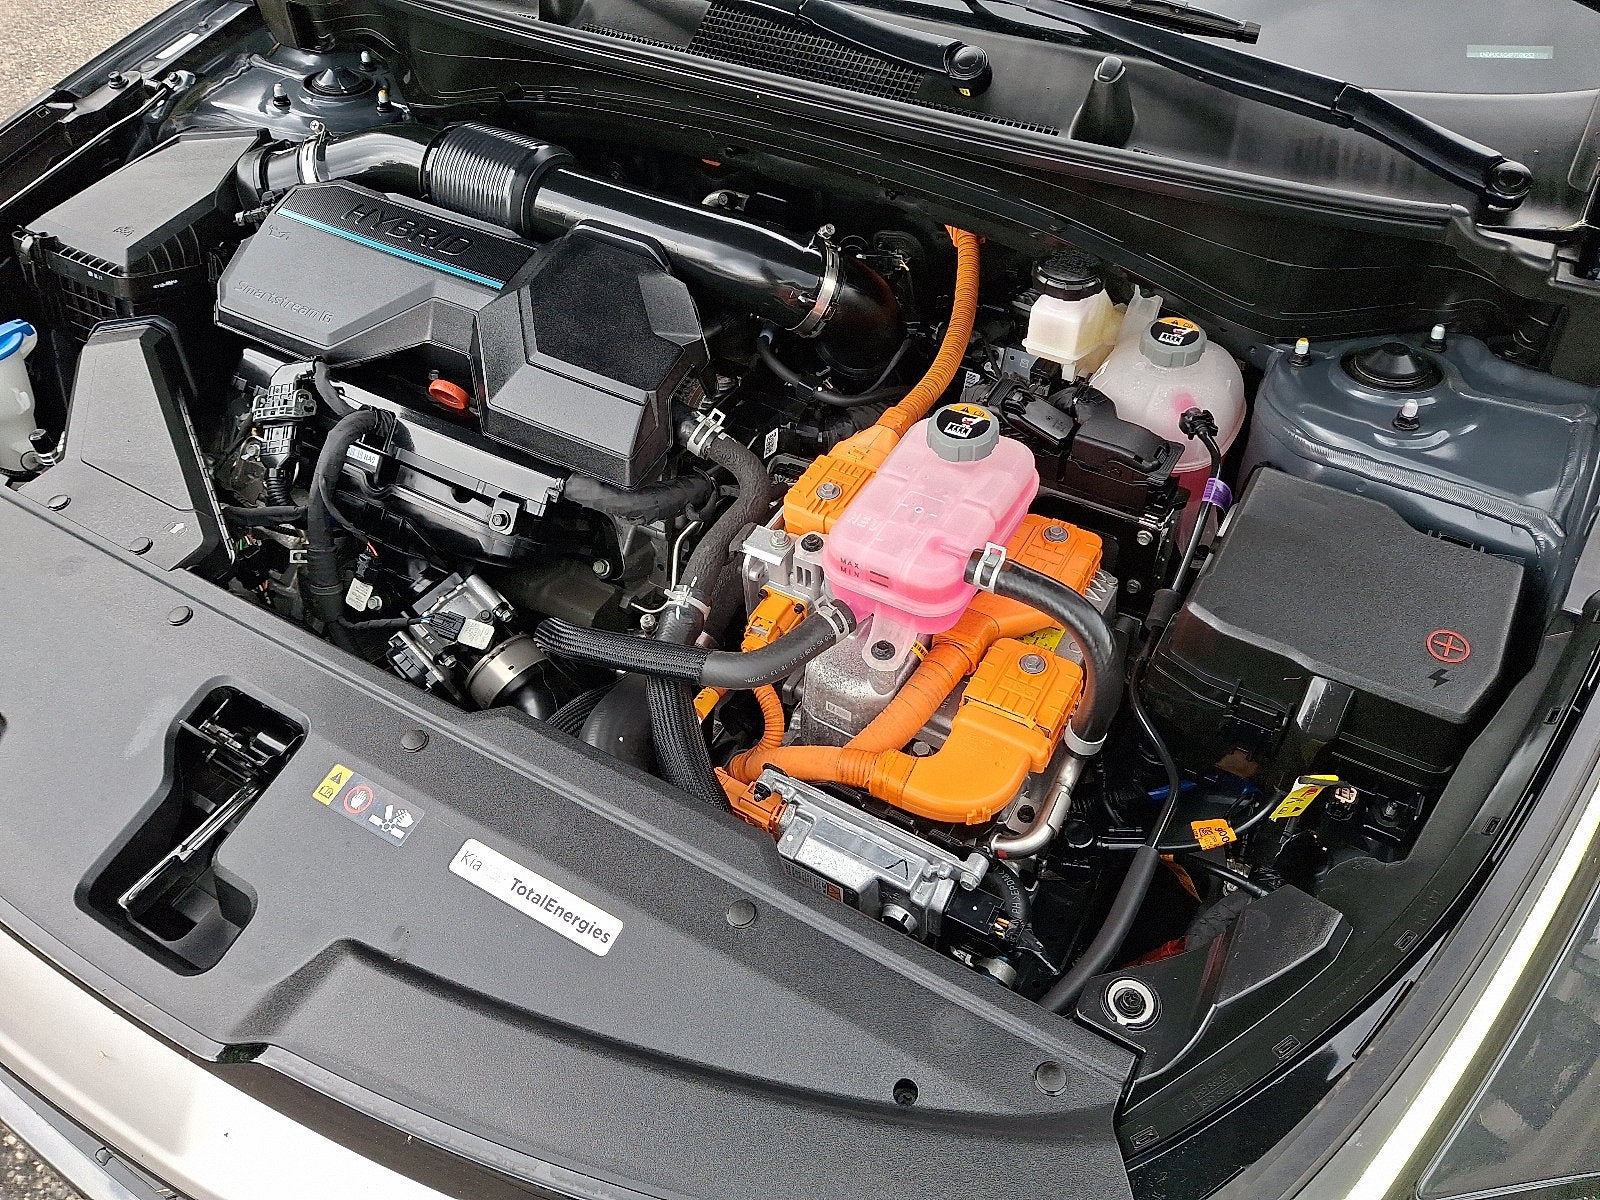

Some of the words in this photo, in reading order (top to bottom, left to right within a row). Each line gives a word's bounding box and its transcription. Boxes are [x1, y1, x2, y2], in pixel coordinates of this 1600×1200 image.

[339, 202, 474, 257] HYBRID
[839, 556, 860, 569] MAX
[839, 566, 860, 578] MIN
[460, 850, 483, 872] Kia
[509, 877, 612, 944] TotalEnergies
